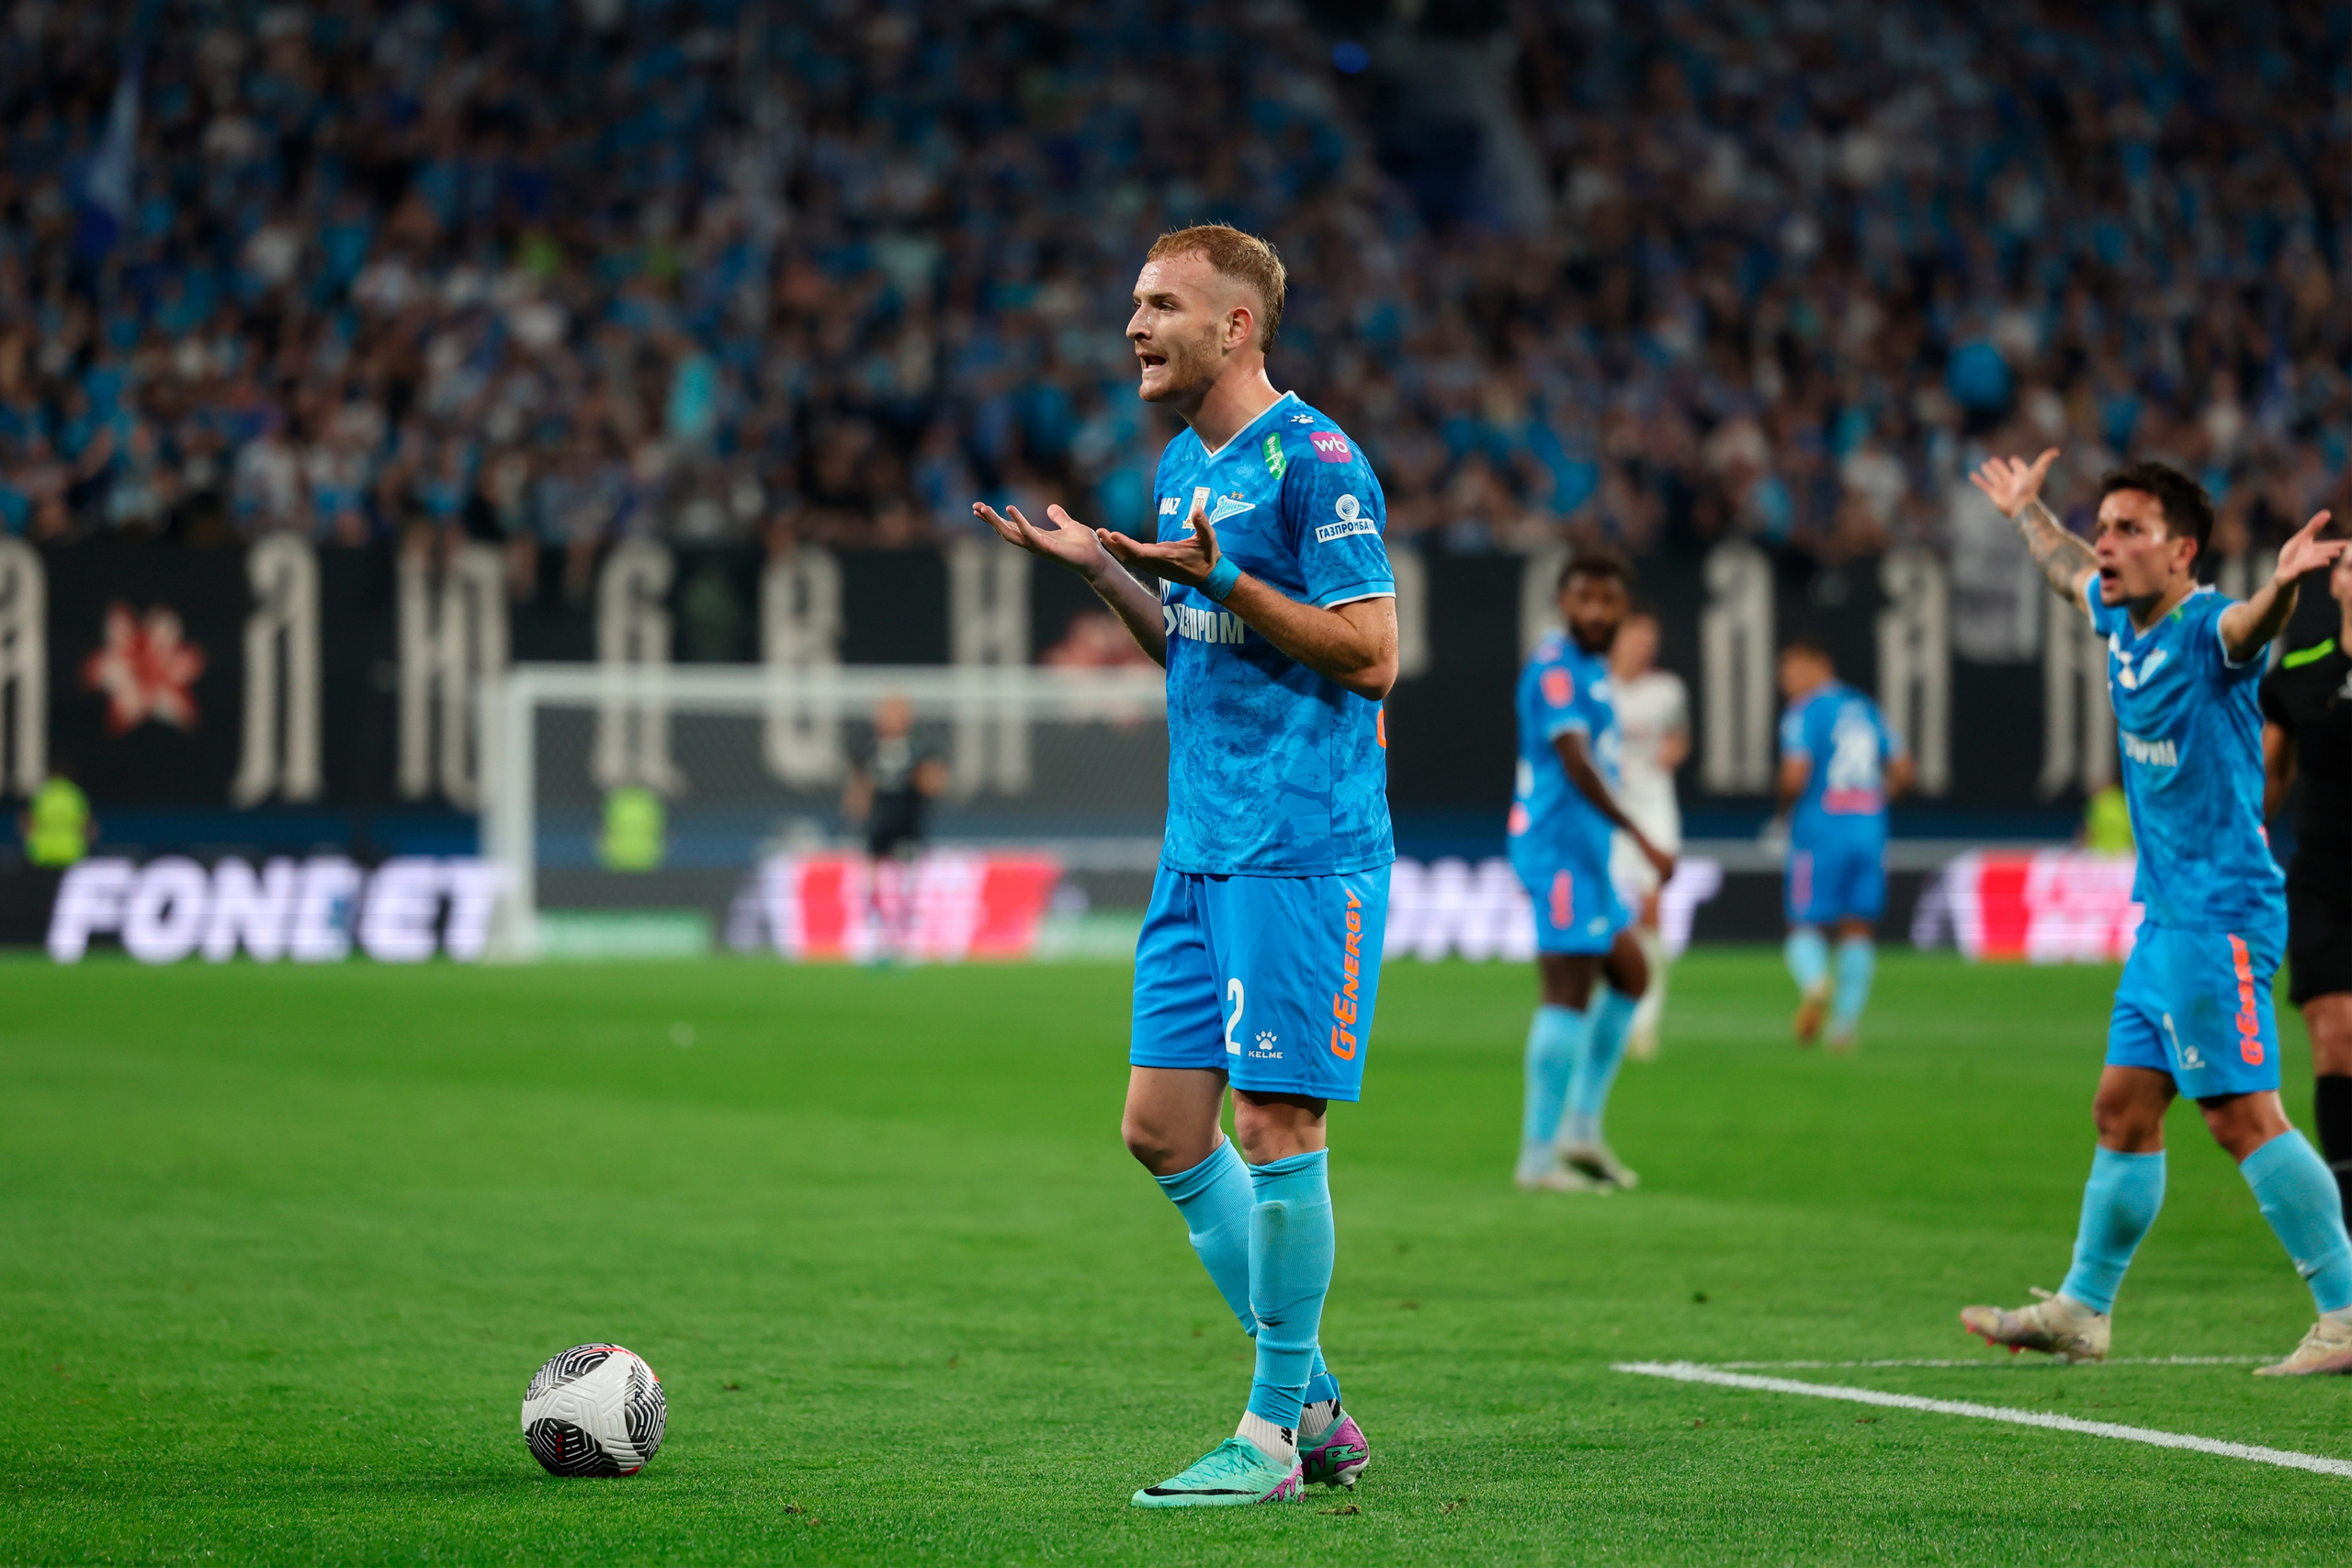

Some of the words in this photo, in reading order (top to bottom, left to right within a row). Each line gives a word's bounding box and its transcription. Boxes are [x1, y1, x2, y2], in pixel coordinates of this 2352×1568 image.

[1313, 436, 1349, 454] wb
[1224, 977, 1245, 1056] 2
[1248, 1050, 1283, 1059] KELME
